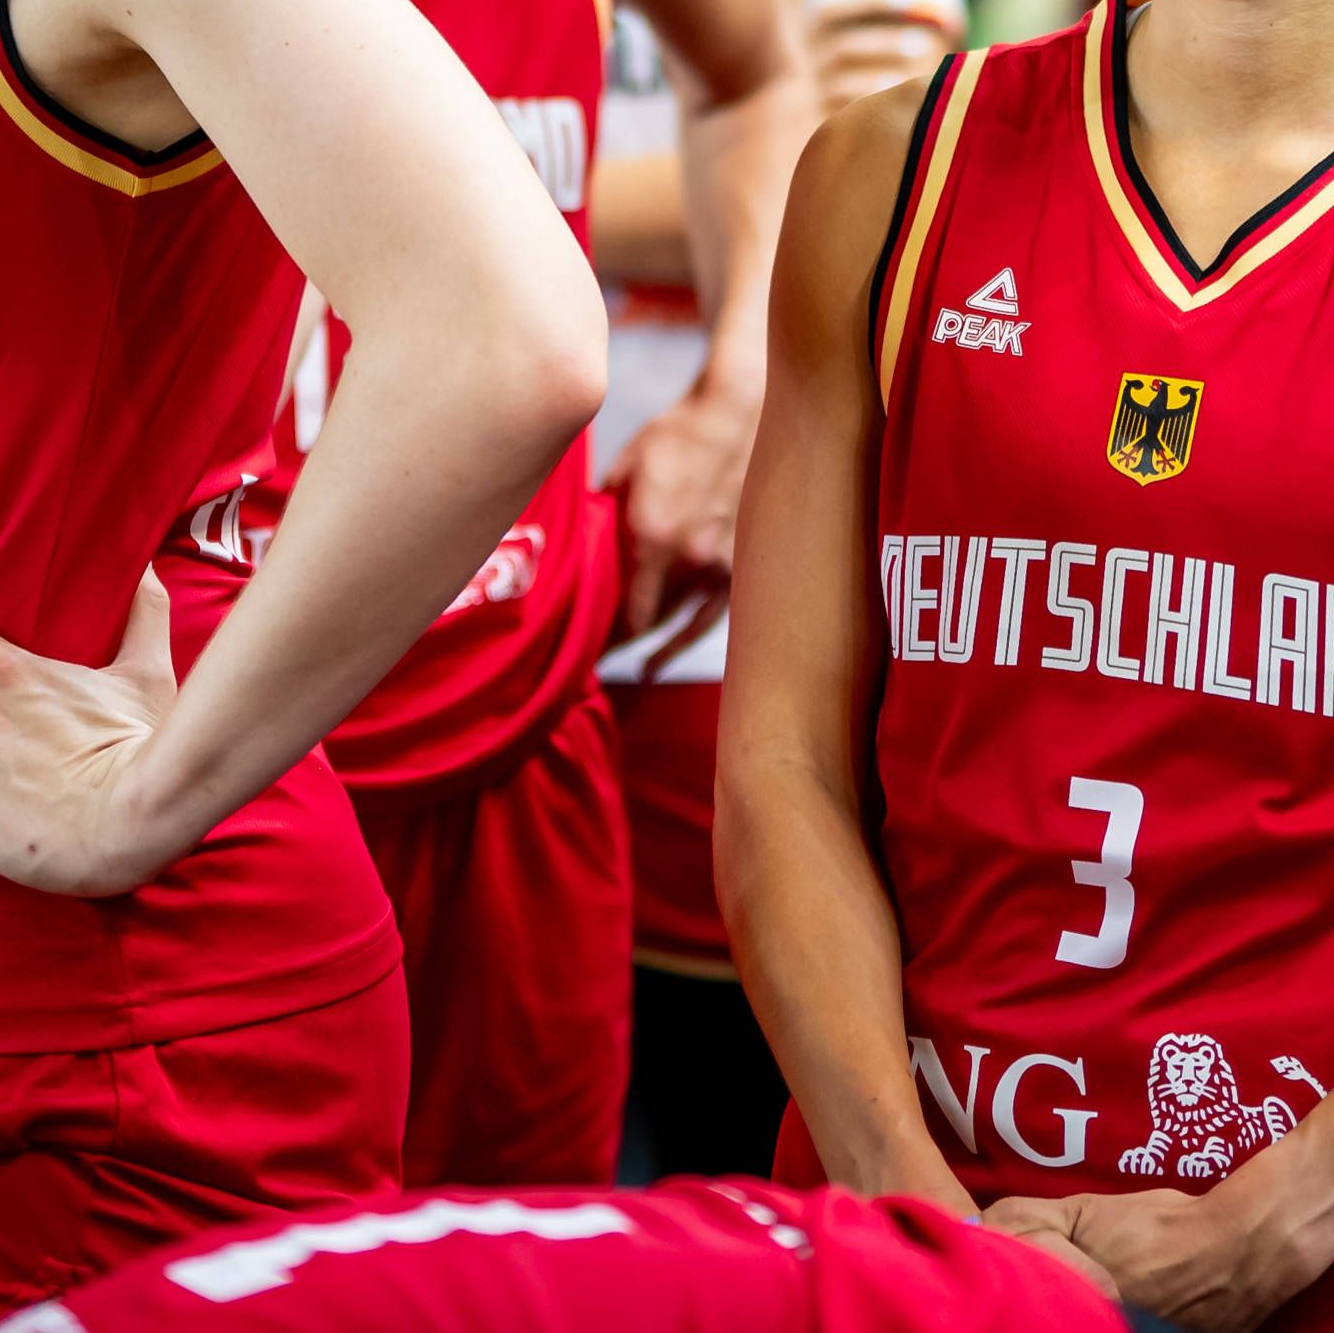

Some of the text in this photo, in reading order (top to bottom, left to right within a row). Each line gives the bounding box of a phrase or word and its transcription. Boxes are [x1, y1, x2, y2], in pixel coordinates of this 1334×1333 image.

[932, 307, 1032, 356] PEAK
[1055, 776, 1145, 969] 3
[908, 1036, 1098, 1168] NG
